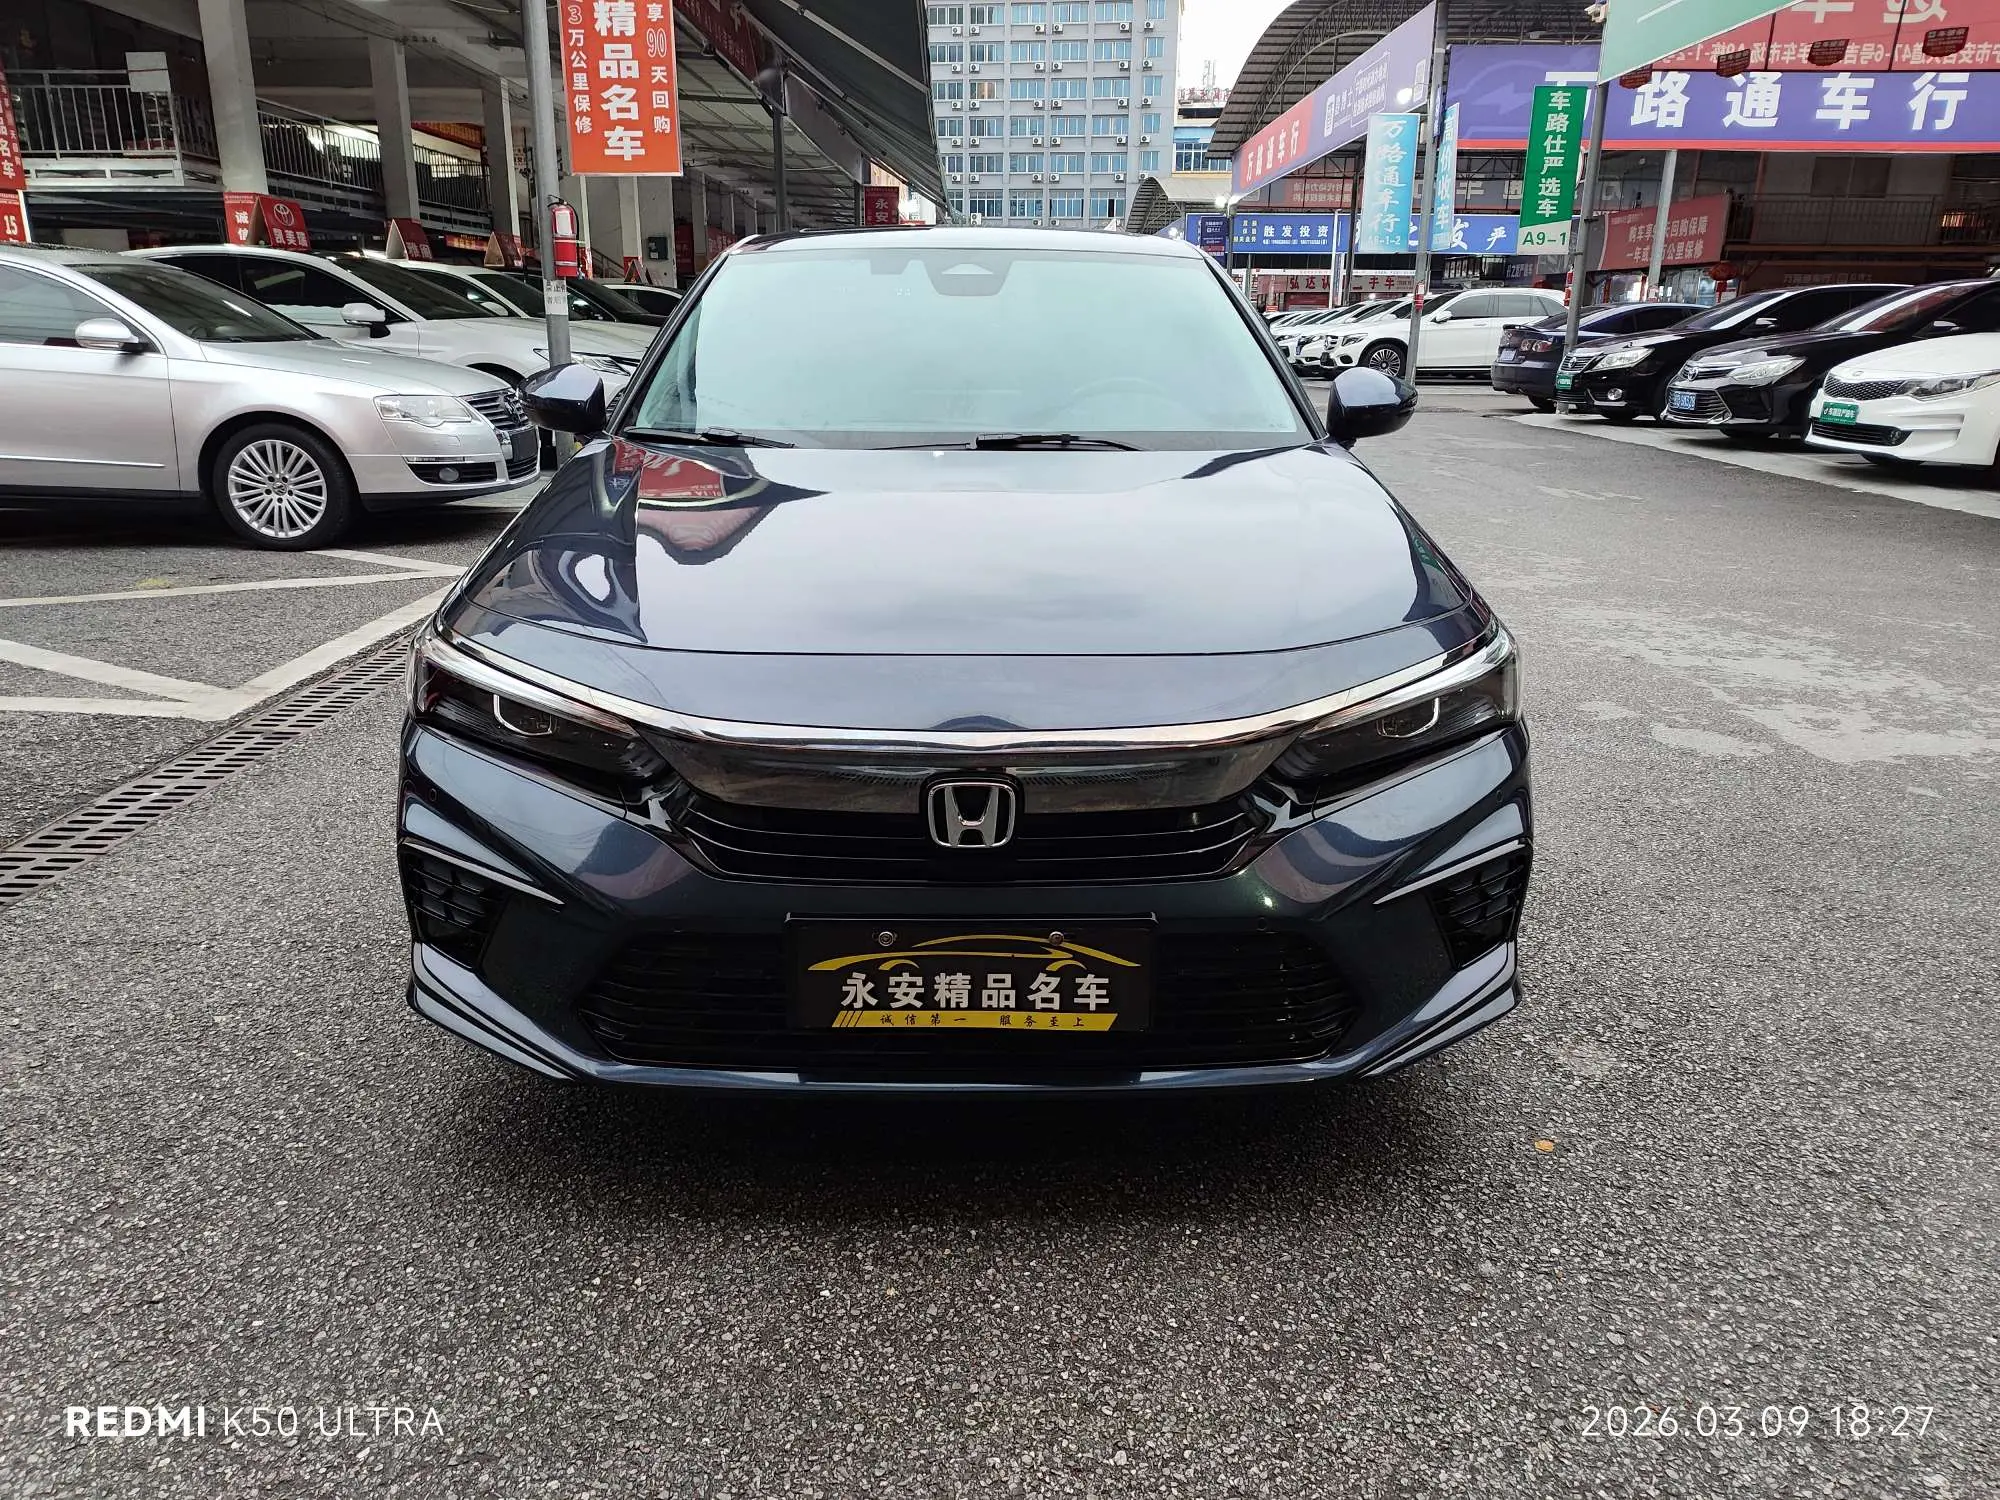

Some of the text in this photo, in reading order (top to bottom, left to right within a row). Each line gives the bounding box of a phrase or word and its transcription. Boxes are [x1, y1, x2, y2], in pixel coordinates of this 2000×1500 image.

[567, 5, 593, 135] 3万公里保修
[593, 0, 646, 161] 精品名车
[646, 3, 671, 134] 享90天回购
[1535, 91, 1571, 218] 车路仕严选车
[1368, 120, 1407, 234] 万路通车行
[4, 215, 18, 235] 15
[1263, 225, 1329, 238] 胜发投资
[1522, 231, 1567, 247] A9-1
[1628, 215, 1709, 242] 购车享回购保障
[1626, 239, 1704, 263] 一年或公里保修
[841, 971, 1110, 1011] 永安精品名车
[880, 1014, 1085, 1028] 诚信第一 服务至上
